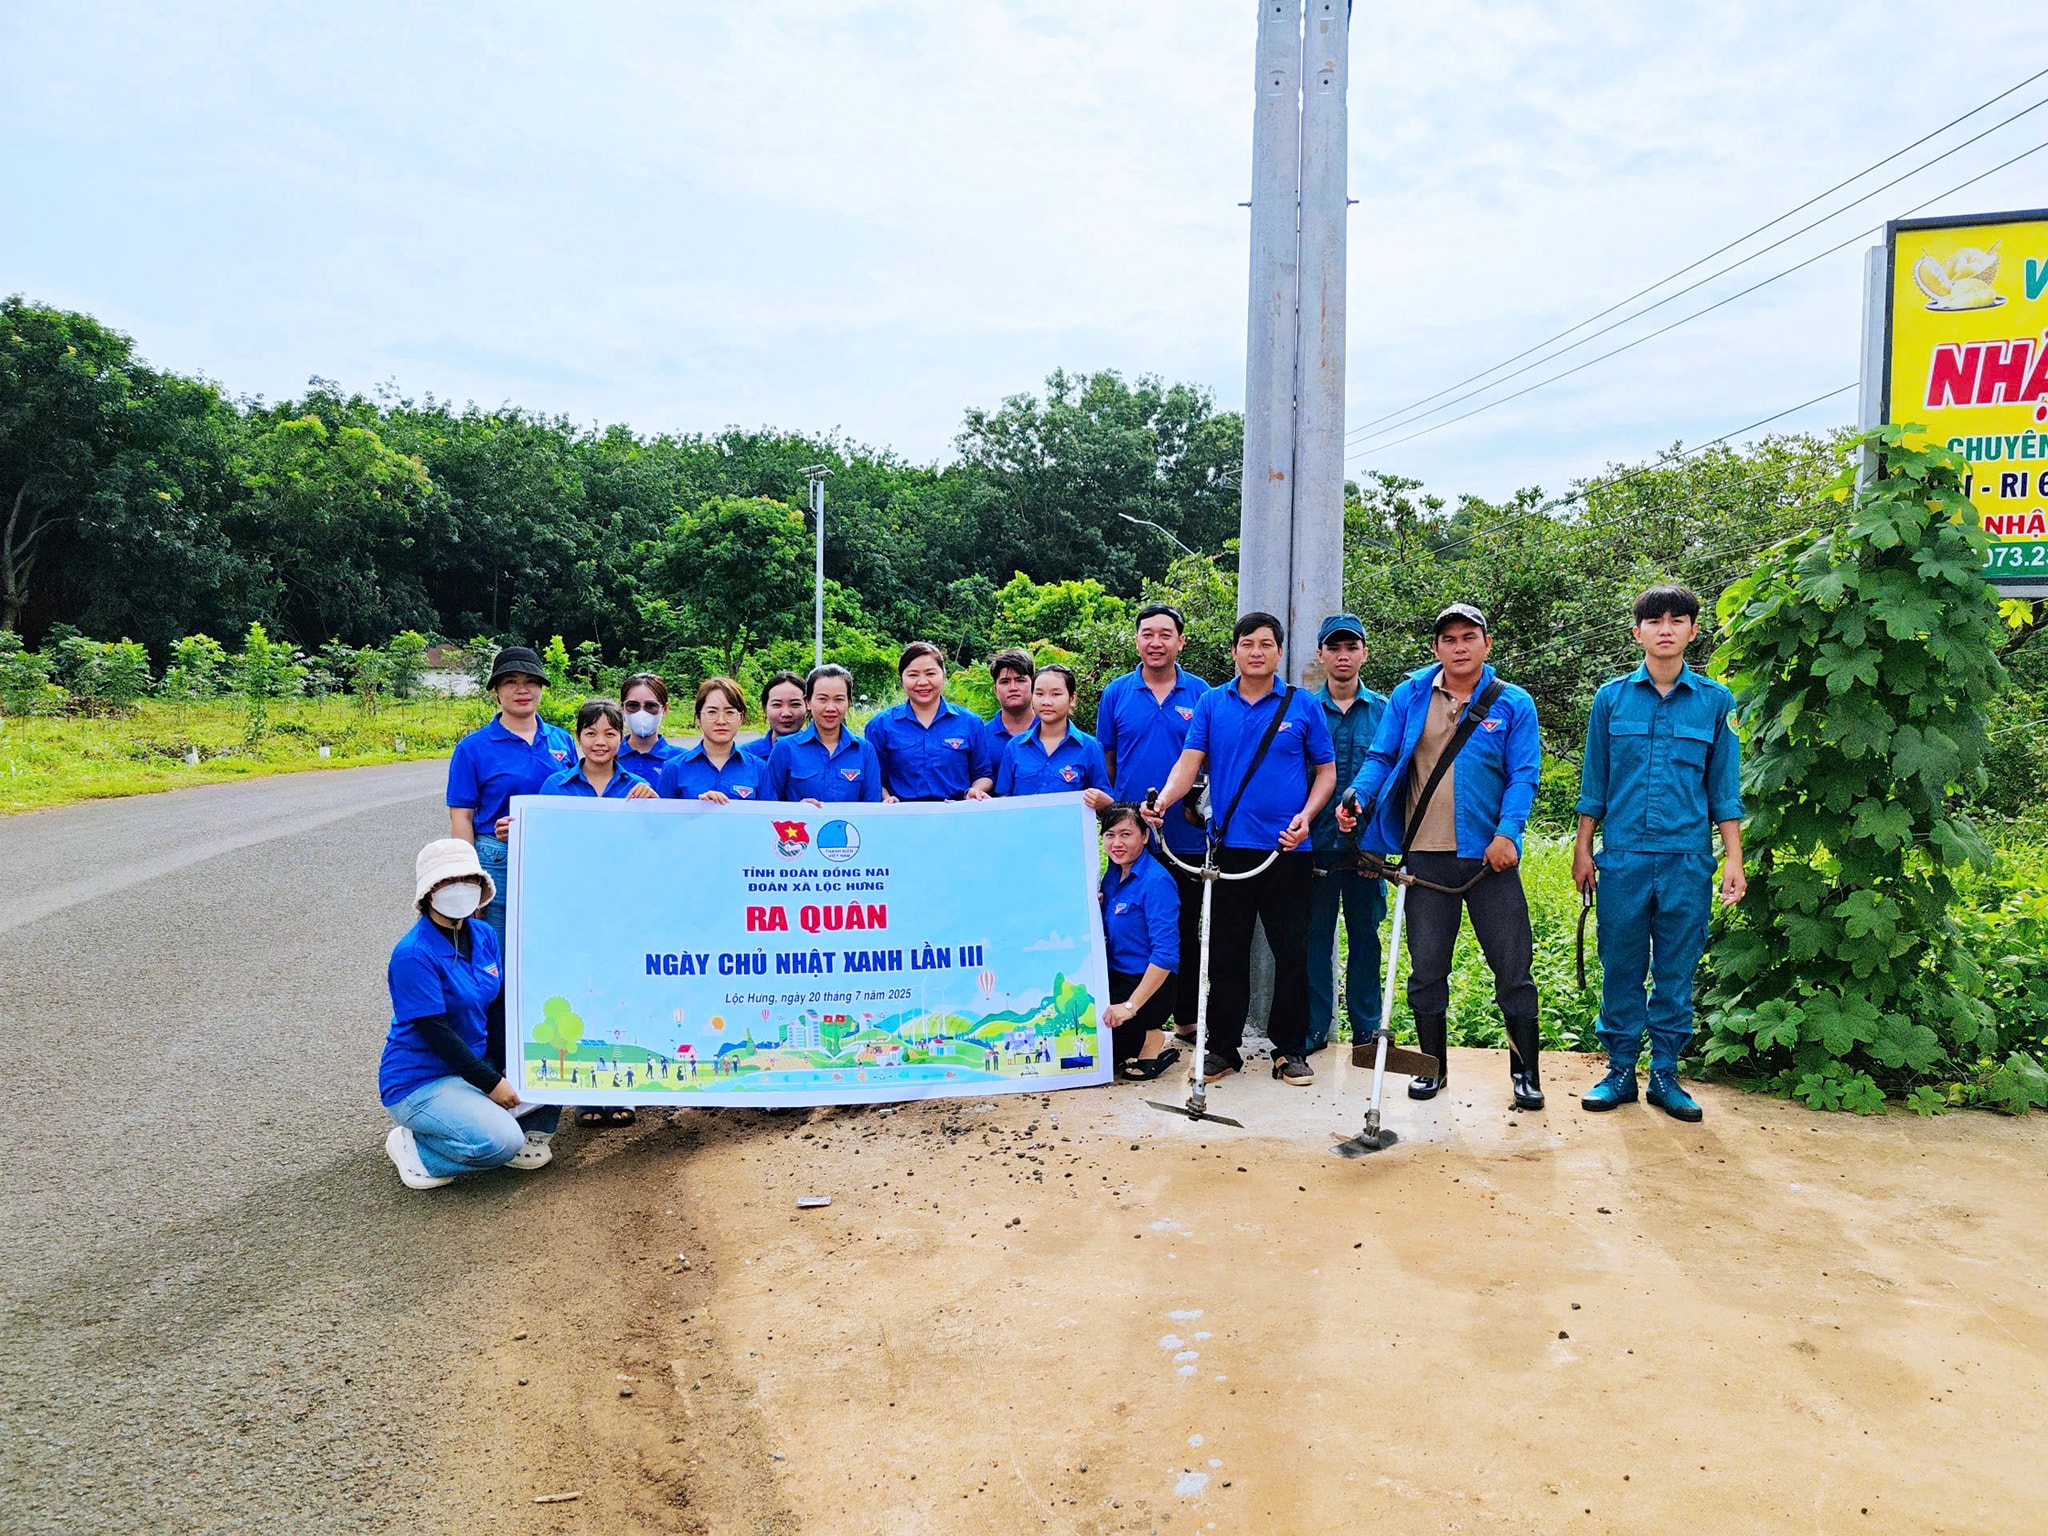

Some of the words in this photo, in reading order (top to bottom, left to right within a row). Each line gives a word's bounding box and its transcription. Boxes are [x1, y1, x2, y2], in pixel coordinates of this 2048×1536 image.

[2000, 472, 2028, 498] RI
[742, 866, 775, 877] TỈNH
[780, 867, 818, 877] ĐOÀN
[865, 868, 889, 877] NAI
[748, 882, 787, 892] ĐOÀN
[816, 881, 841, 893] LỘC
[846, 881, 884, 891] HƯNG
[746, 905, 789, 931] RA
[799, 900, 887, 933] QUÂN
[645, 951, 710, 976] NGÀY
[718, 948, 767, 976] CHỦ
[775, 948, 836, 978] NHẬT
[843, 950, 903, 973] XANH
[911, 941, 951, 971] LẦN
[959, 945, 983, 967] III
[725, 993, 745, 1005] Lộc
[747, 993, 778, 1005] Hưng,
[781, 992, 806, 1005] ngày
[808, 992, 821, 1002] 20
[823, 991, 852, 1004] tháng
[855, 990, 862, 1001] 7
[864, 990, 885, 1000] năm
[888, 989, 912, 1000] 2025
